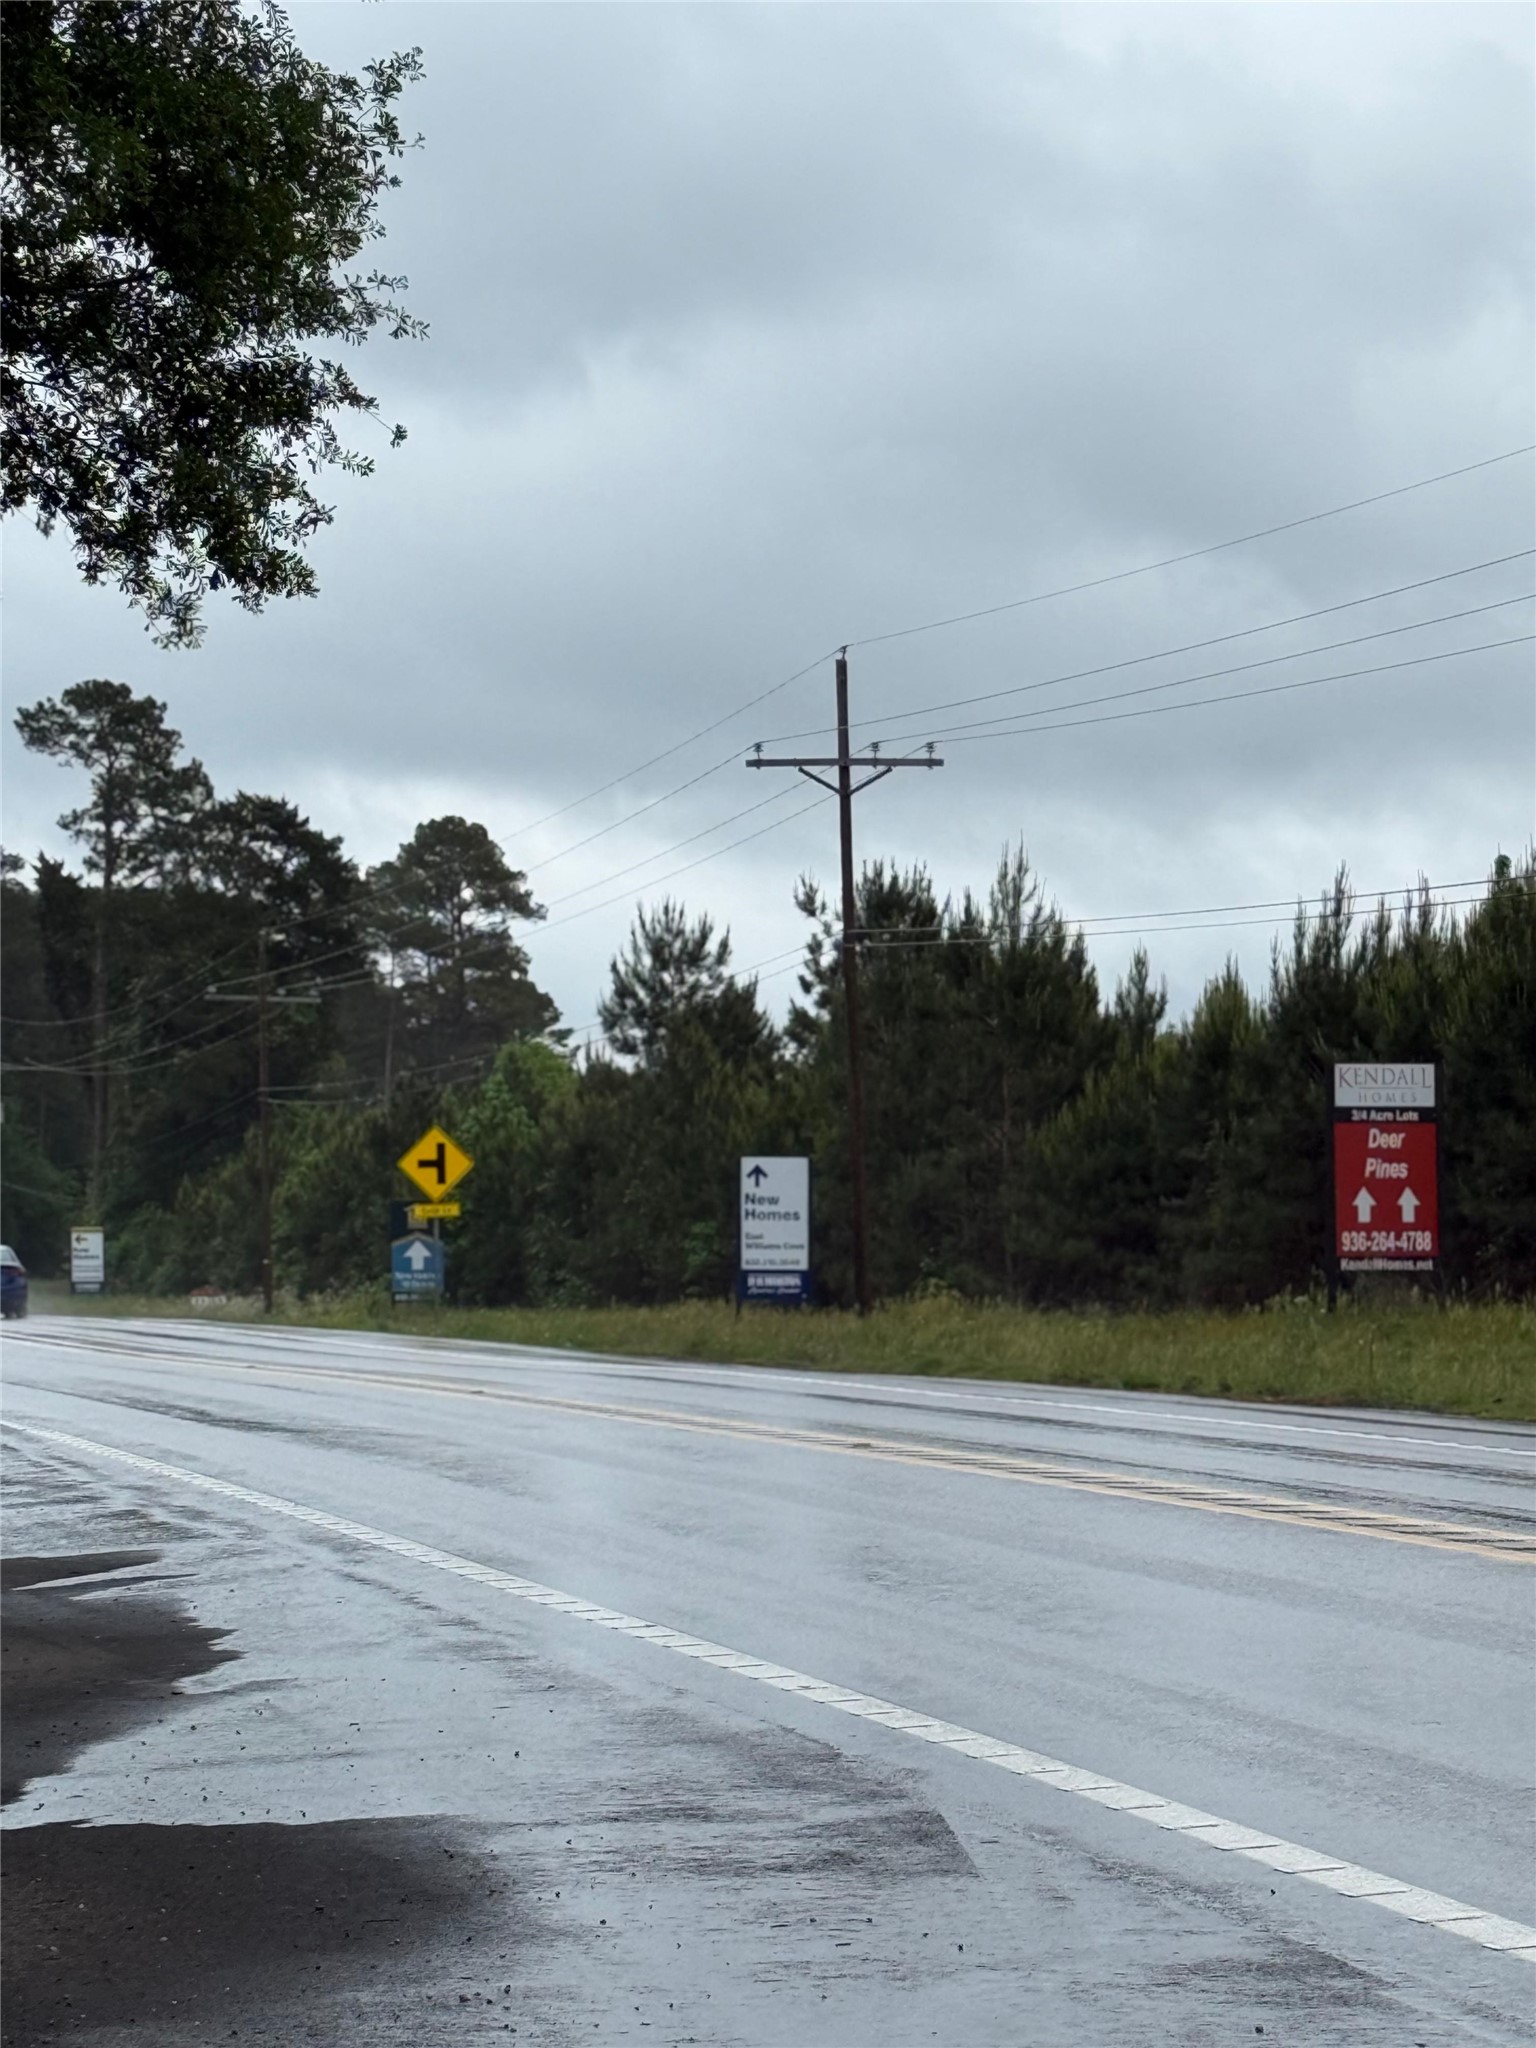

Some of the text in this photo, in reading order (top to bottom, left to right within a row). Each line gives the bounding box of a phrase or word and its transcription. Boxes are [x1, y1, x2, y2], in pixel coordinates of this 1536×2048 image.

[1339, 1067, 1432, 1088] KENDALL
[1358, 1092, 1417, 1103] HOMES
[1351, 1109, 1419, 1121] 3/4 Acre Lots
[1368, 1127, 1406, 1149] Deer
[1365, 1158, 1409, 1179] Pines
[745, 1193, 780, 1205] New
[745, 1208, 800, 1221] Homes
[1341, 1231, 1432, 1252] 936-264-4788
